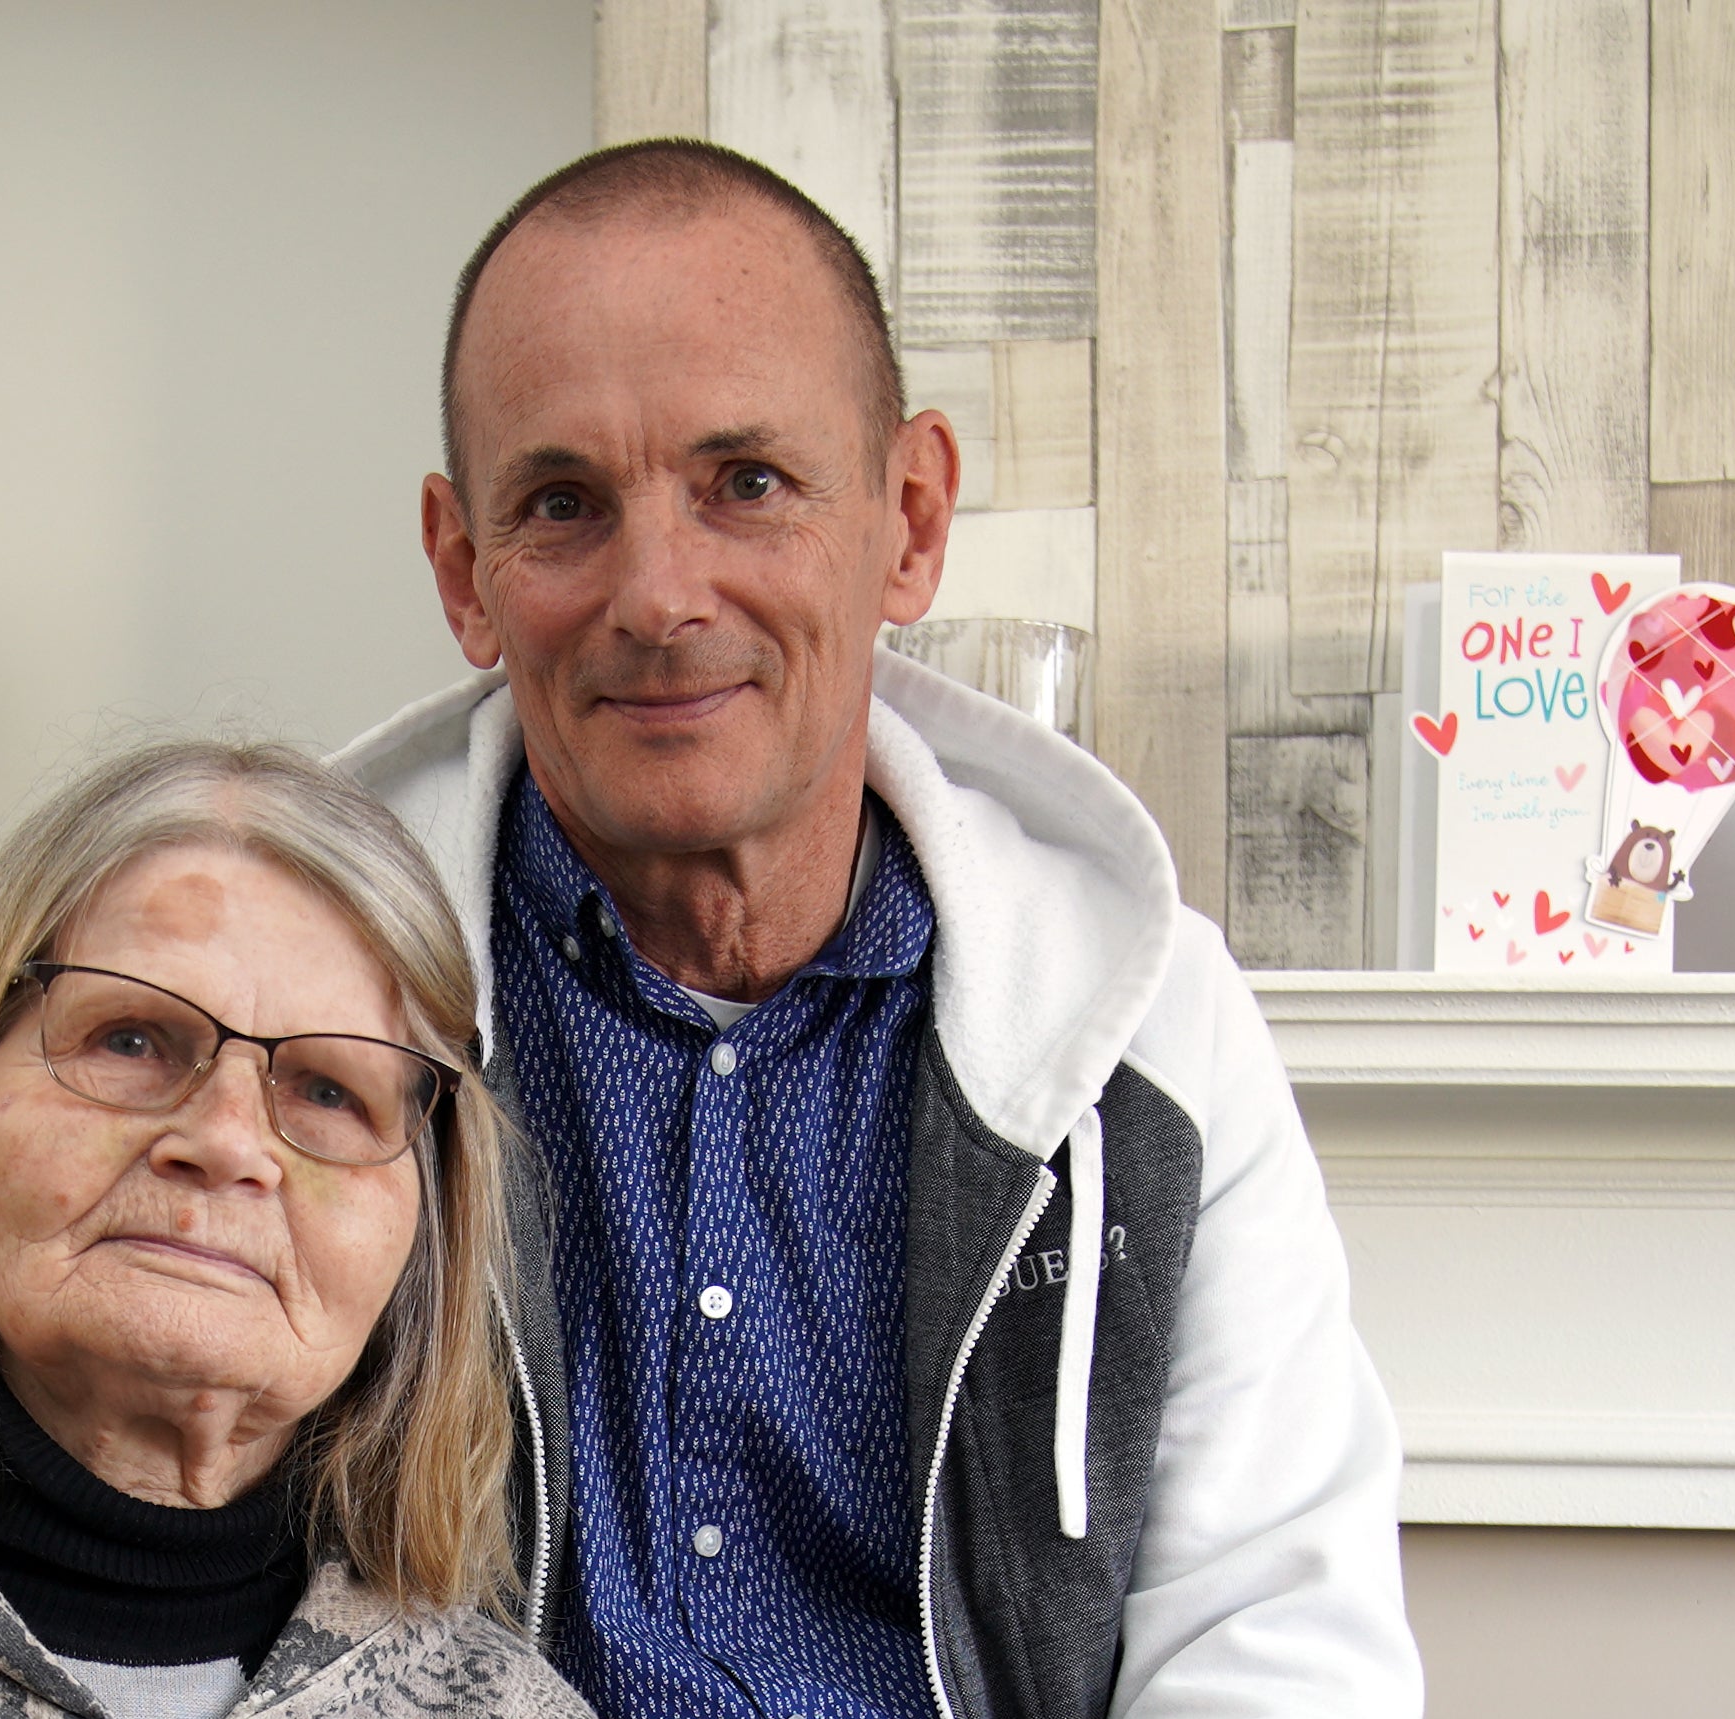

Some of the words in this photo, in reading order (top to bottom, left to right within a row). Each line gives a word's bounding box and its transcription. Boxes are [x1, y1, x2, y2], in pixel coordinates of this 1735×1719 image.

[1468, 584, 1515, 608] For
[1525, 576, 1567, 607] the
[1568, 617, 1584, 658] I
[1458, 771, 1504, 800] Every
[1509, 770, 1550, 788] time
[1502, 796, 1544, 820] with
